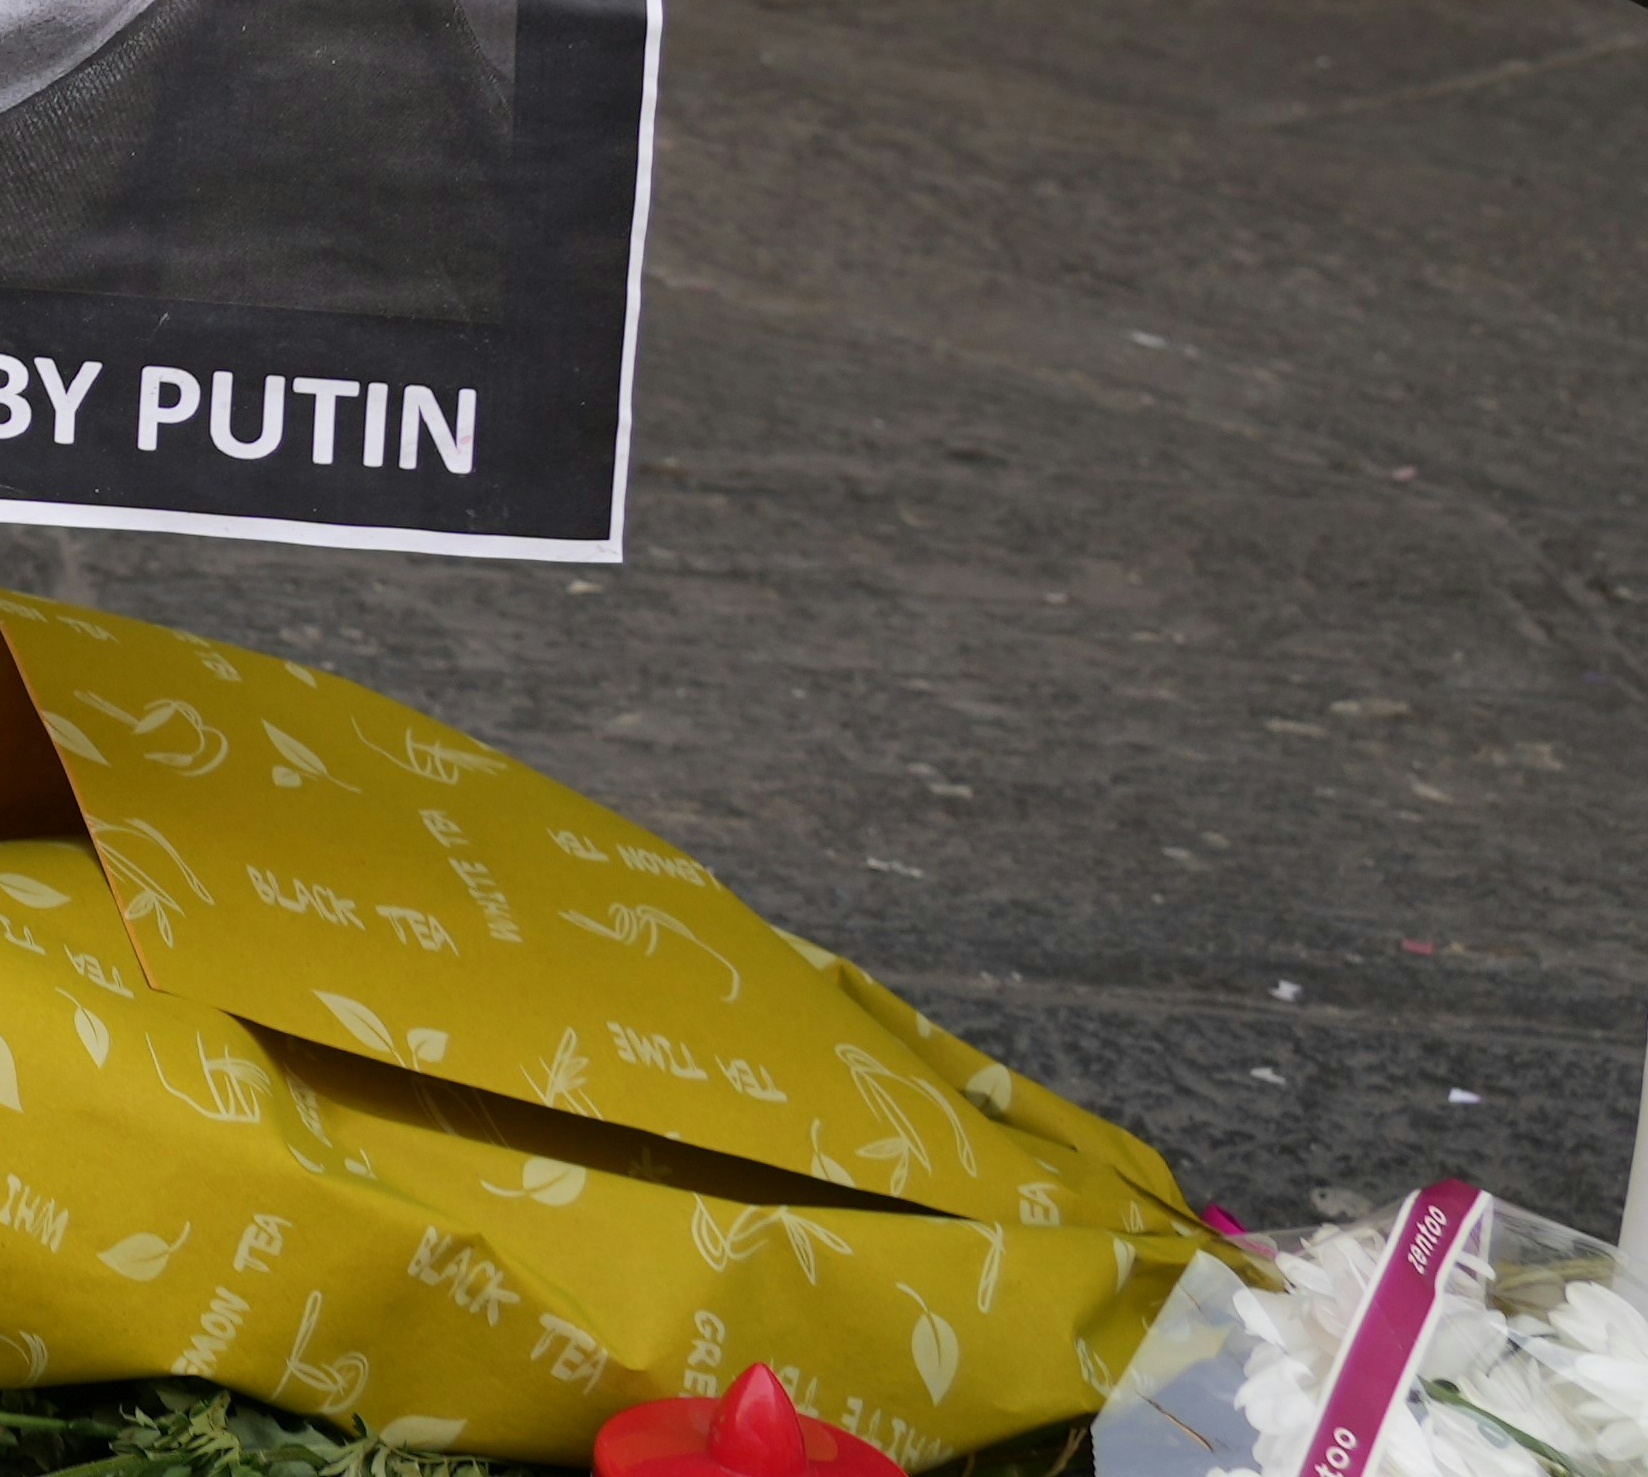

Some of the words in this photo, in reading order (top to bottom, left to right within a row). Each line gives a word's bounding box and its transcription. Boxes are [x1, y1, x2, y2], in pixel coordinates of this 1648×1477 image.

[137, 365, 478, 475] PUTIN
[245, 864, 365, 930] BLACK
[375, 905, 459, 957] TEA
[63, 944, 135, 1000] TEA
[604, 1019, 709, 1082] TIME
[713, 1053, 788, 1104] TEA
[231, 1212, 293, 1274] TEA
[1406, 1204, 1448, 1276] zentoo
[406, 1223, 521, 1328] BLACK
[529, 1312, 610, 1397] TEA
